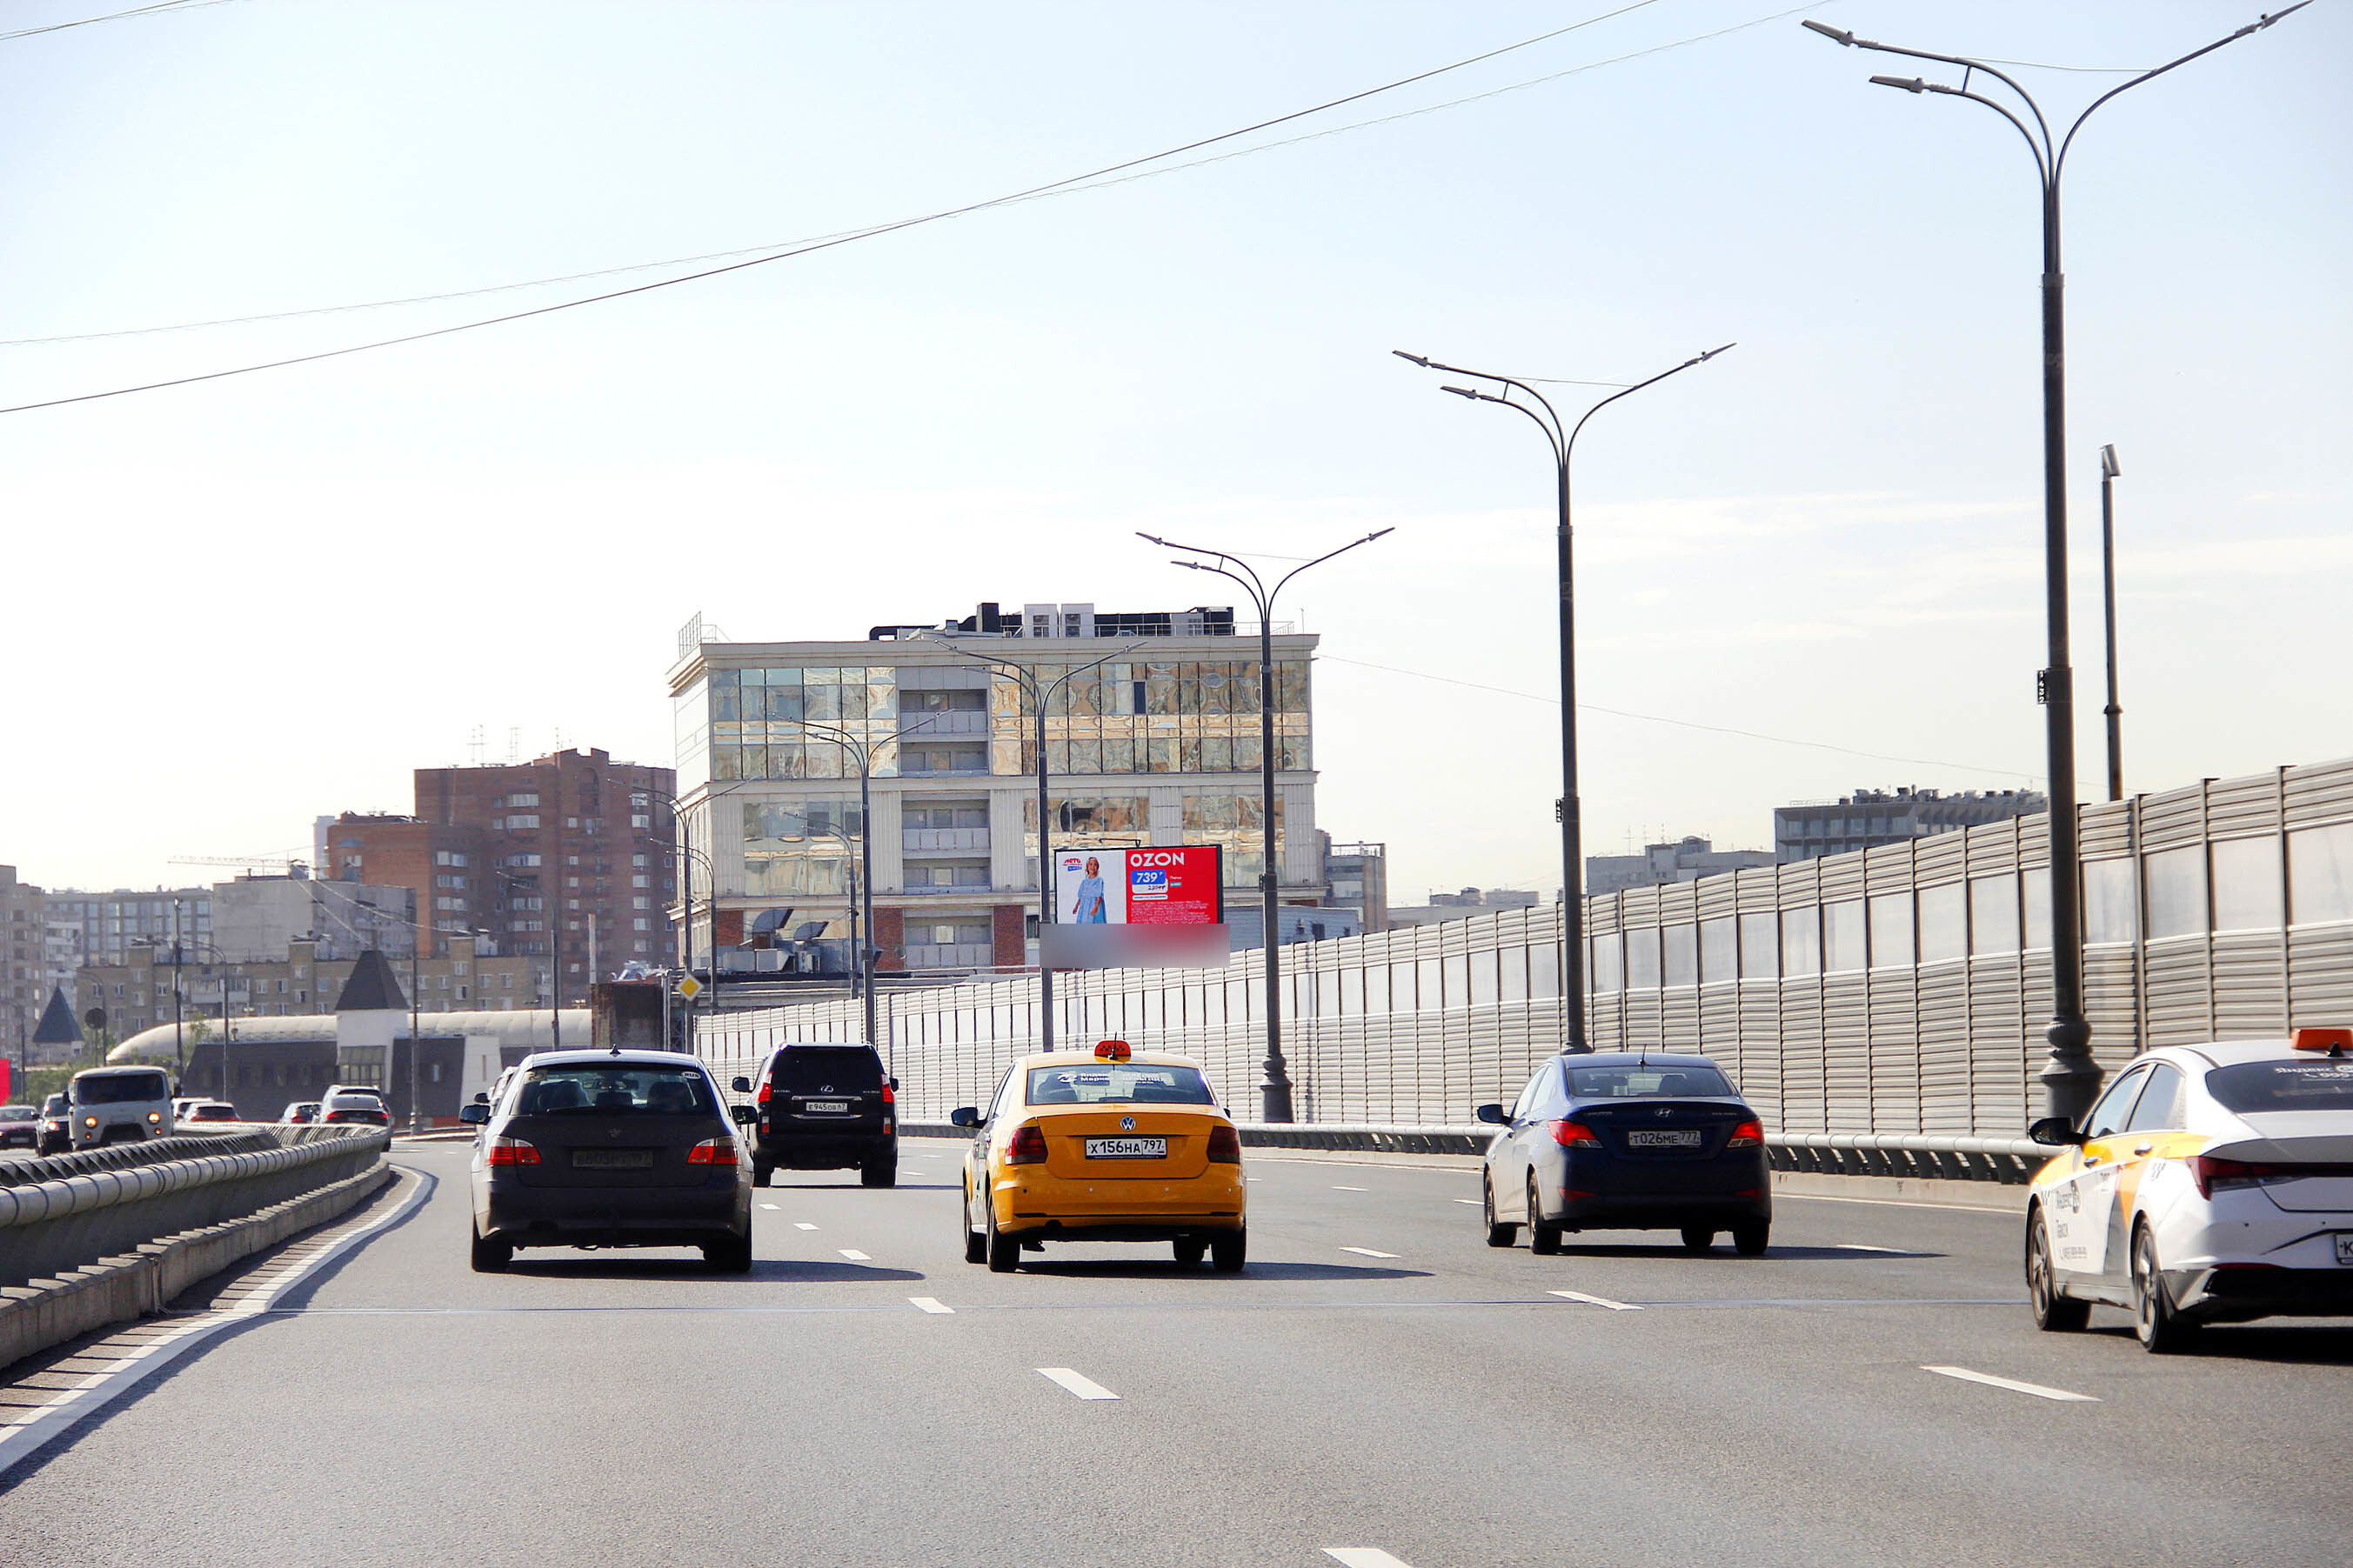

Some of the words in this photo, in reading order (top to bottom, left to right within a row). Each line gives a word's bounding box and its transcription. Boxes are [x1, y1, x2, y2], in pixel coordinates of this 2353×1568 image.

[1130, 851, 1185, 867] OZON
[1136, 871, 1158, 883] 739
[1681, 1131, 1697, 1141] 777
[1091, 1140, 1140, 1154] Х156НА
[1143, 1139, 1162, 1150] 797
